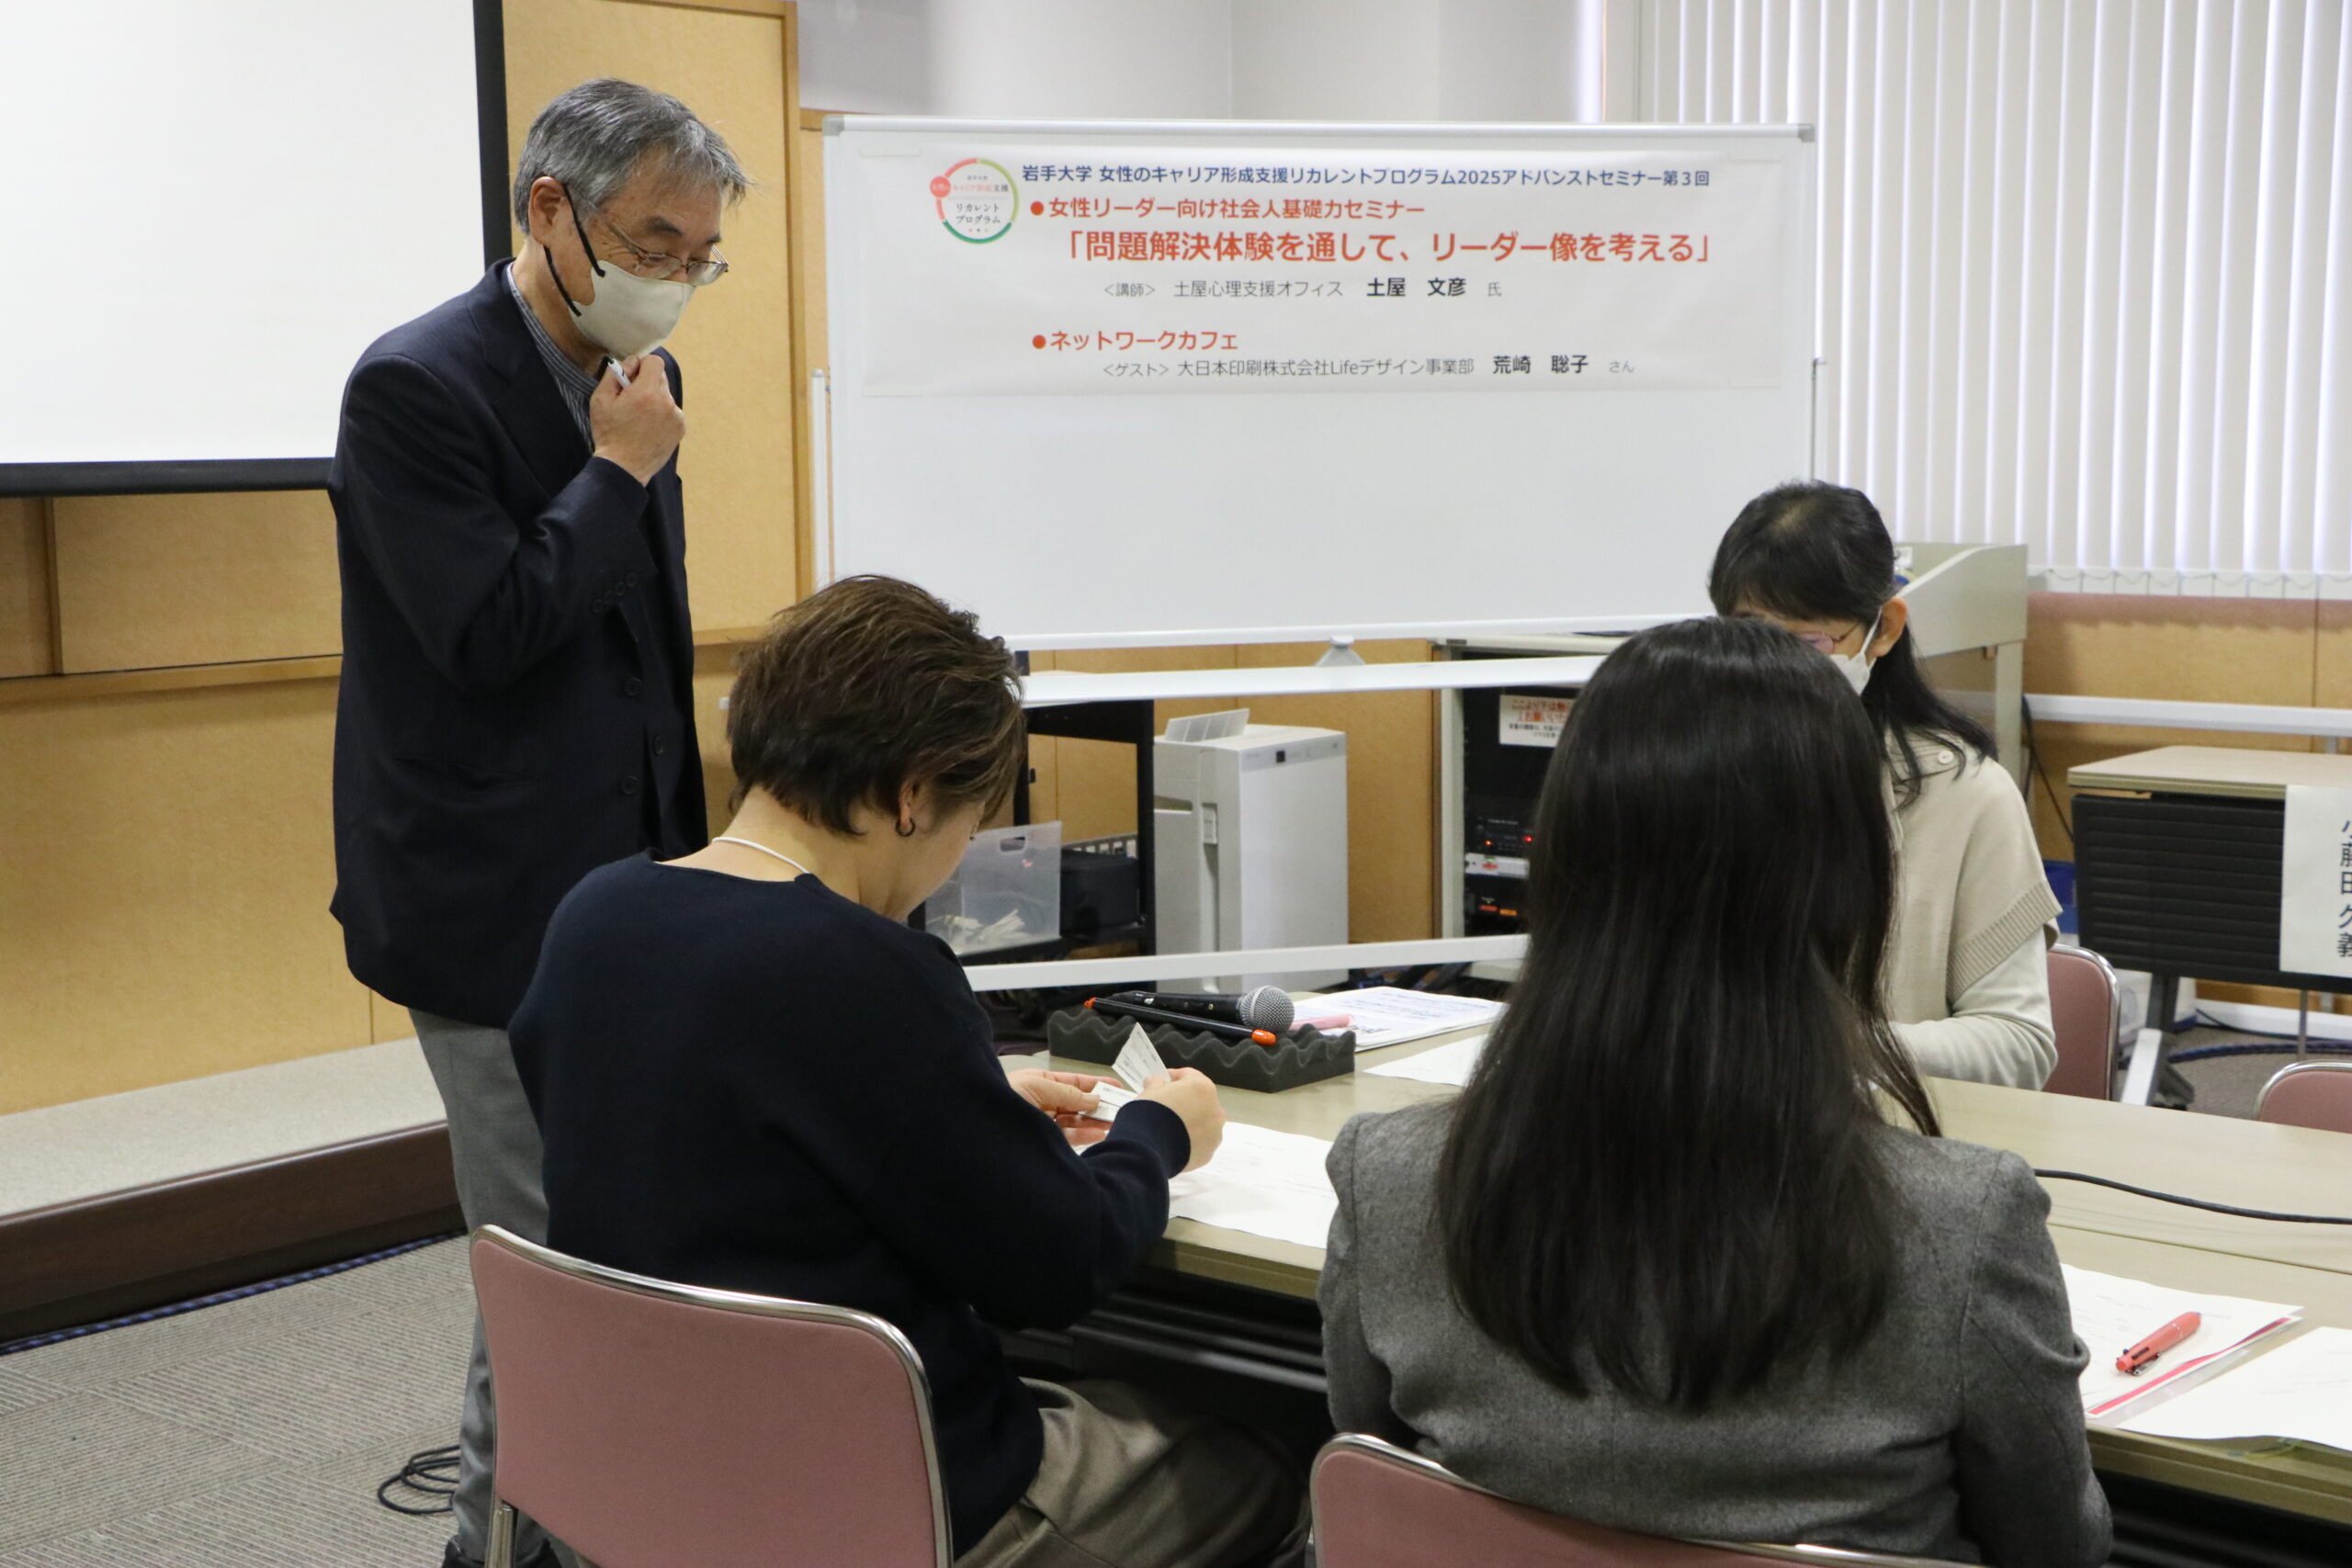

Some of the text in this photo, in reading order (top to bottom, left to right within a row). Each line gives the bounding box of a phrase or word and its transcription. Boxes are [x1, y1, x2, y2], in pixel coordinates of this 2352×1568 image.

[1022, 164, 1710, 186] 岩手大学 女性のキャリア形成支援リカレントプログラム2025アドバンストセミナー第3回
[956, 203, 1000, 213] リカレント
[1048, 197, 1425, 220] 女性リーダー向け社会人基礎力セミナー
[956, 214, 1001, 224] プログラム
[1070, 230, 1709, 263] 「問題解決体験を通して、リーダー像を考える」
[1174, 280, 1343, 298] 土屋心理支援オフィス
[1366, 277, 1407, 298] 土屋
[1427, 277, 1467, 298] 文彦
[1487, 282, 1502, 297] 氏
[1049, 330, 1238, 351] ネットワークカフェ
[1177, 358, 1475, 377] 大日本印刷株式会社Lifeデザイン事業部
[1492, 355, 1532, 376] 荒崎
[1550, 355, 1589, 376] 聡子
[1609, 360, 1635, 374] さん
